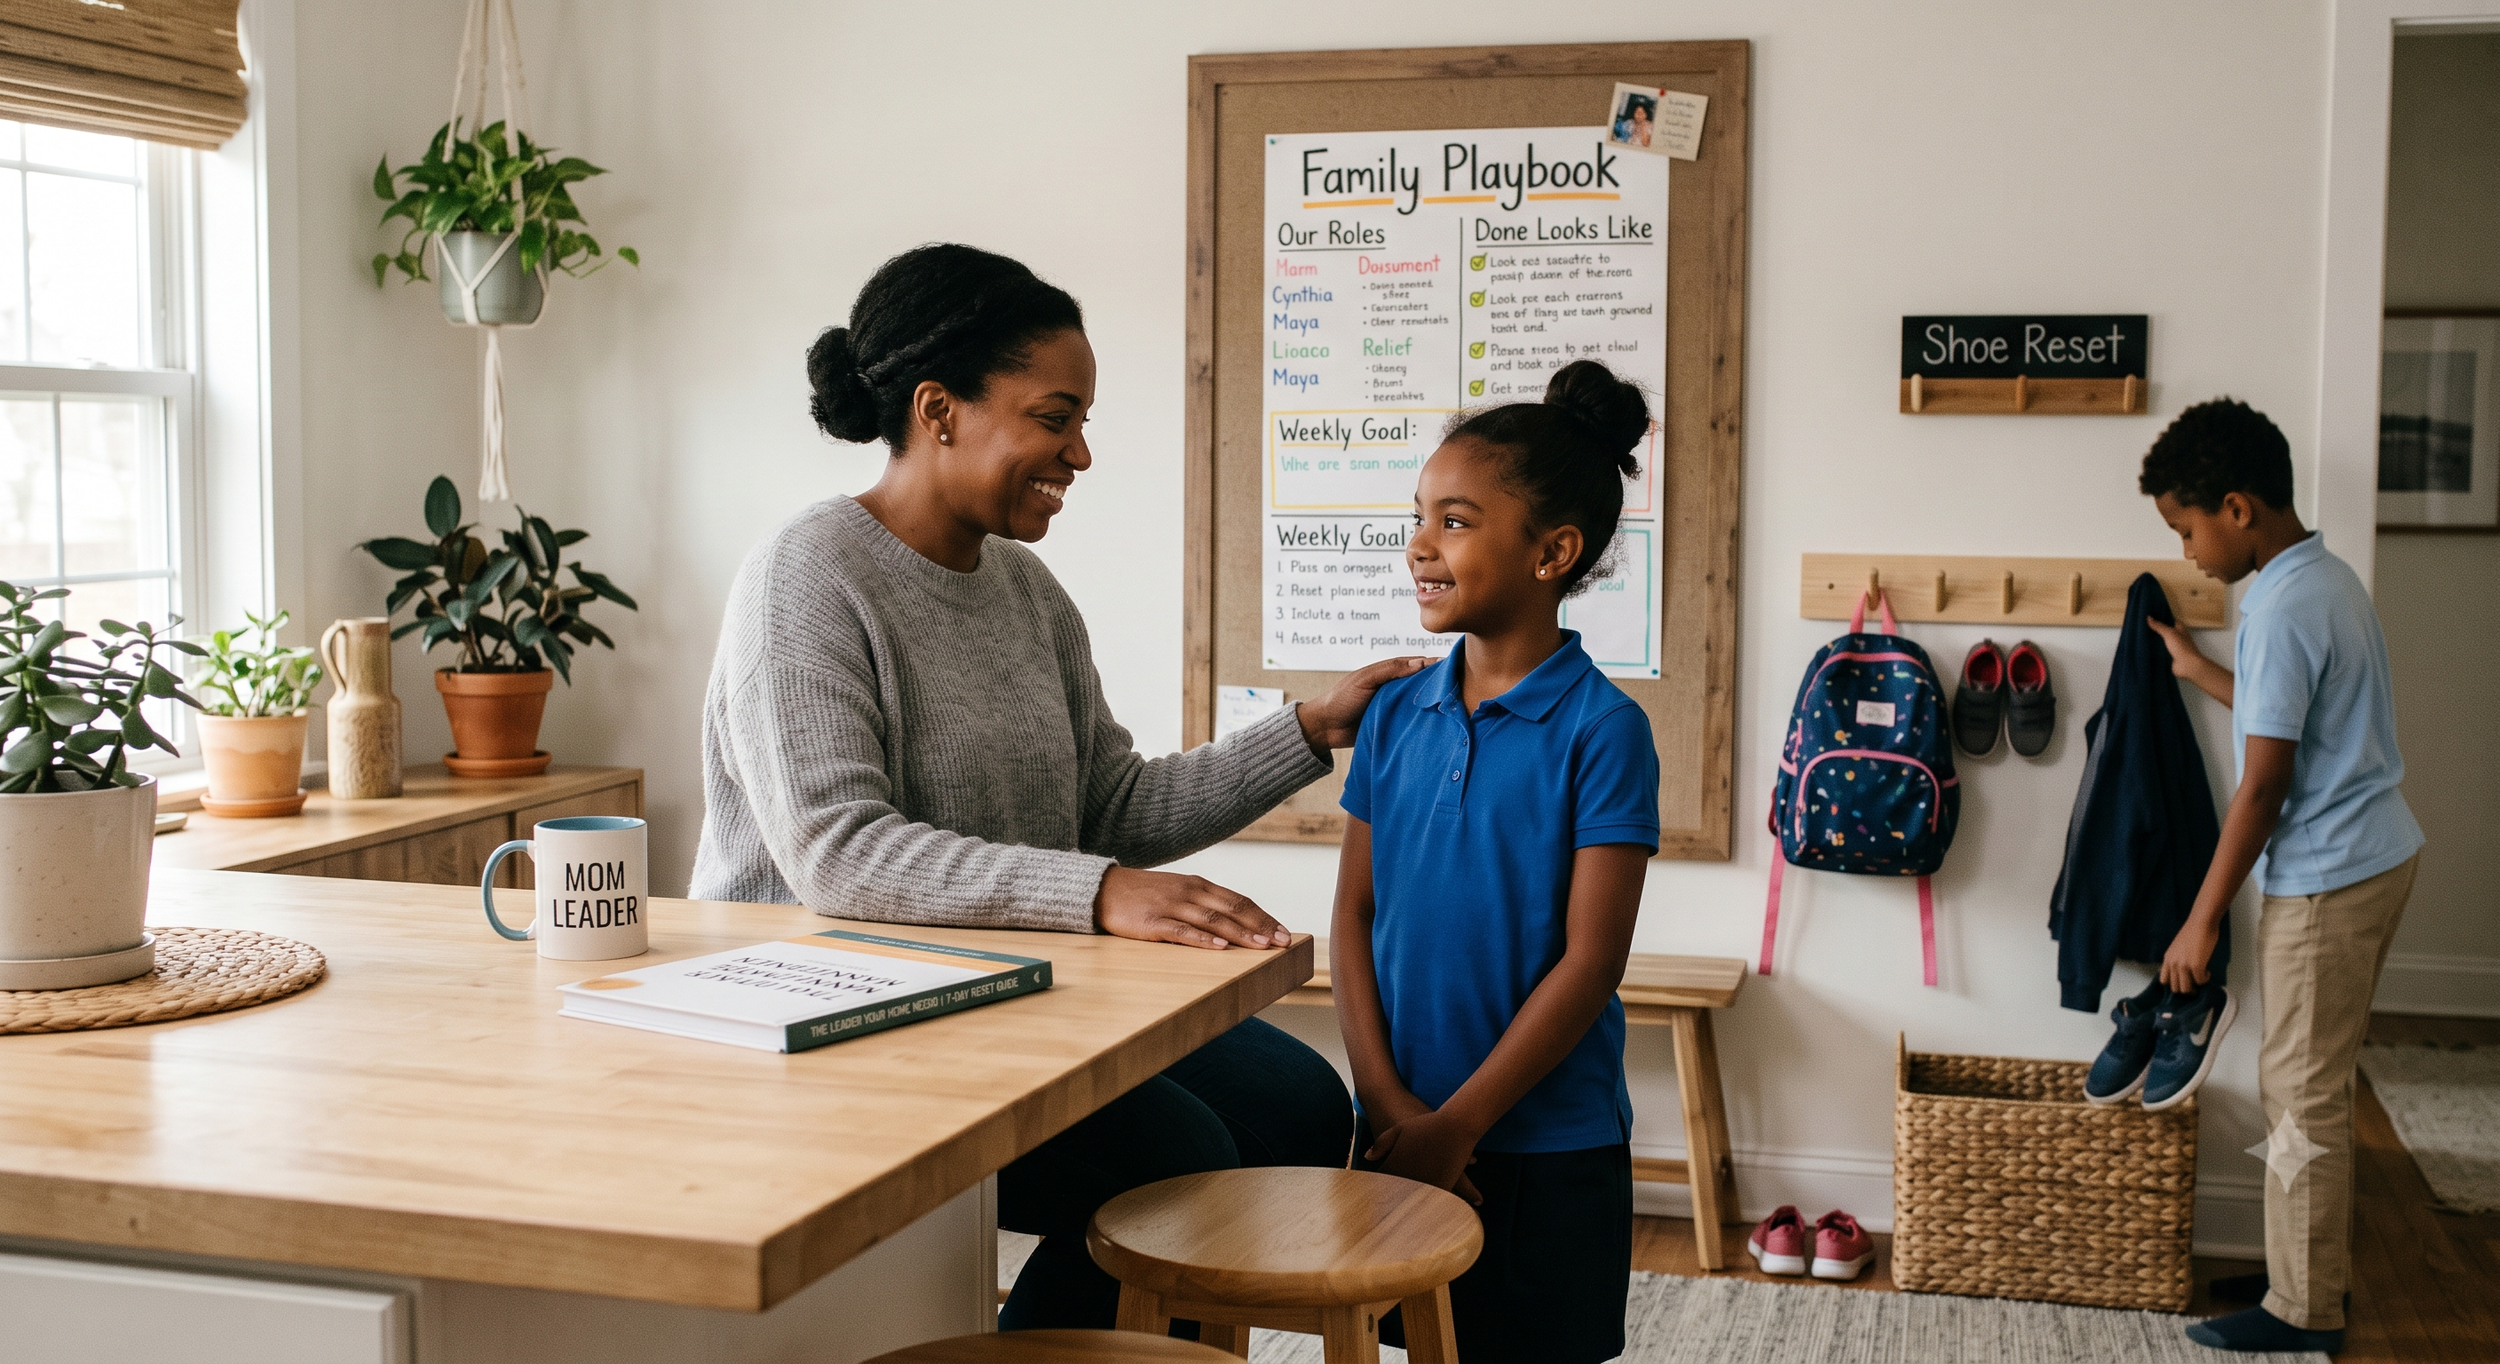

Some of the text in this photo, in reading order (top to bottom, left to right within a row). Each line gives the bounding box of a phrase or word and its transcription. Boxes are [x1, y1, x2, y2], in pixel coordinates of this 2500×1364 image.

[1303, 141, 1620, 215] Family Playbook
[1277, 220, 1386, 247] Our Roles
[1475, 215, 1653, 242] Done Looks Like
[1272, 285, 1333, 311] Cynthia
[1273, 313, 1319, 337] Maya
[1362, 337, 1413, 357] Relief
[1922, 323, 2125, 365] Shoe Reset
[1490, 359, 1512, 371] and
[1272, 368, 1319, 393] Maya
[1490, 381, 1512, 395] Get
[1279, 417, 1417, 451] Weekly Goal:
[1317, 460, 1340, 471] are
[1277, 523, 1351, 555] Weekly
[1323, 563, 1338, 573] on
[1291, 584, 1323, 597] Reset
[1337, 611, 1345, 620] a
[565, 860, 625, 892] MOM
[553, 895, 638, 929] LEADER
[810, 1024, 828, 1038] THE
